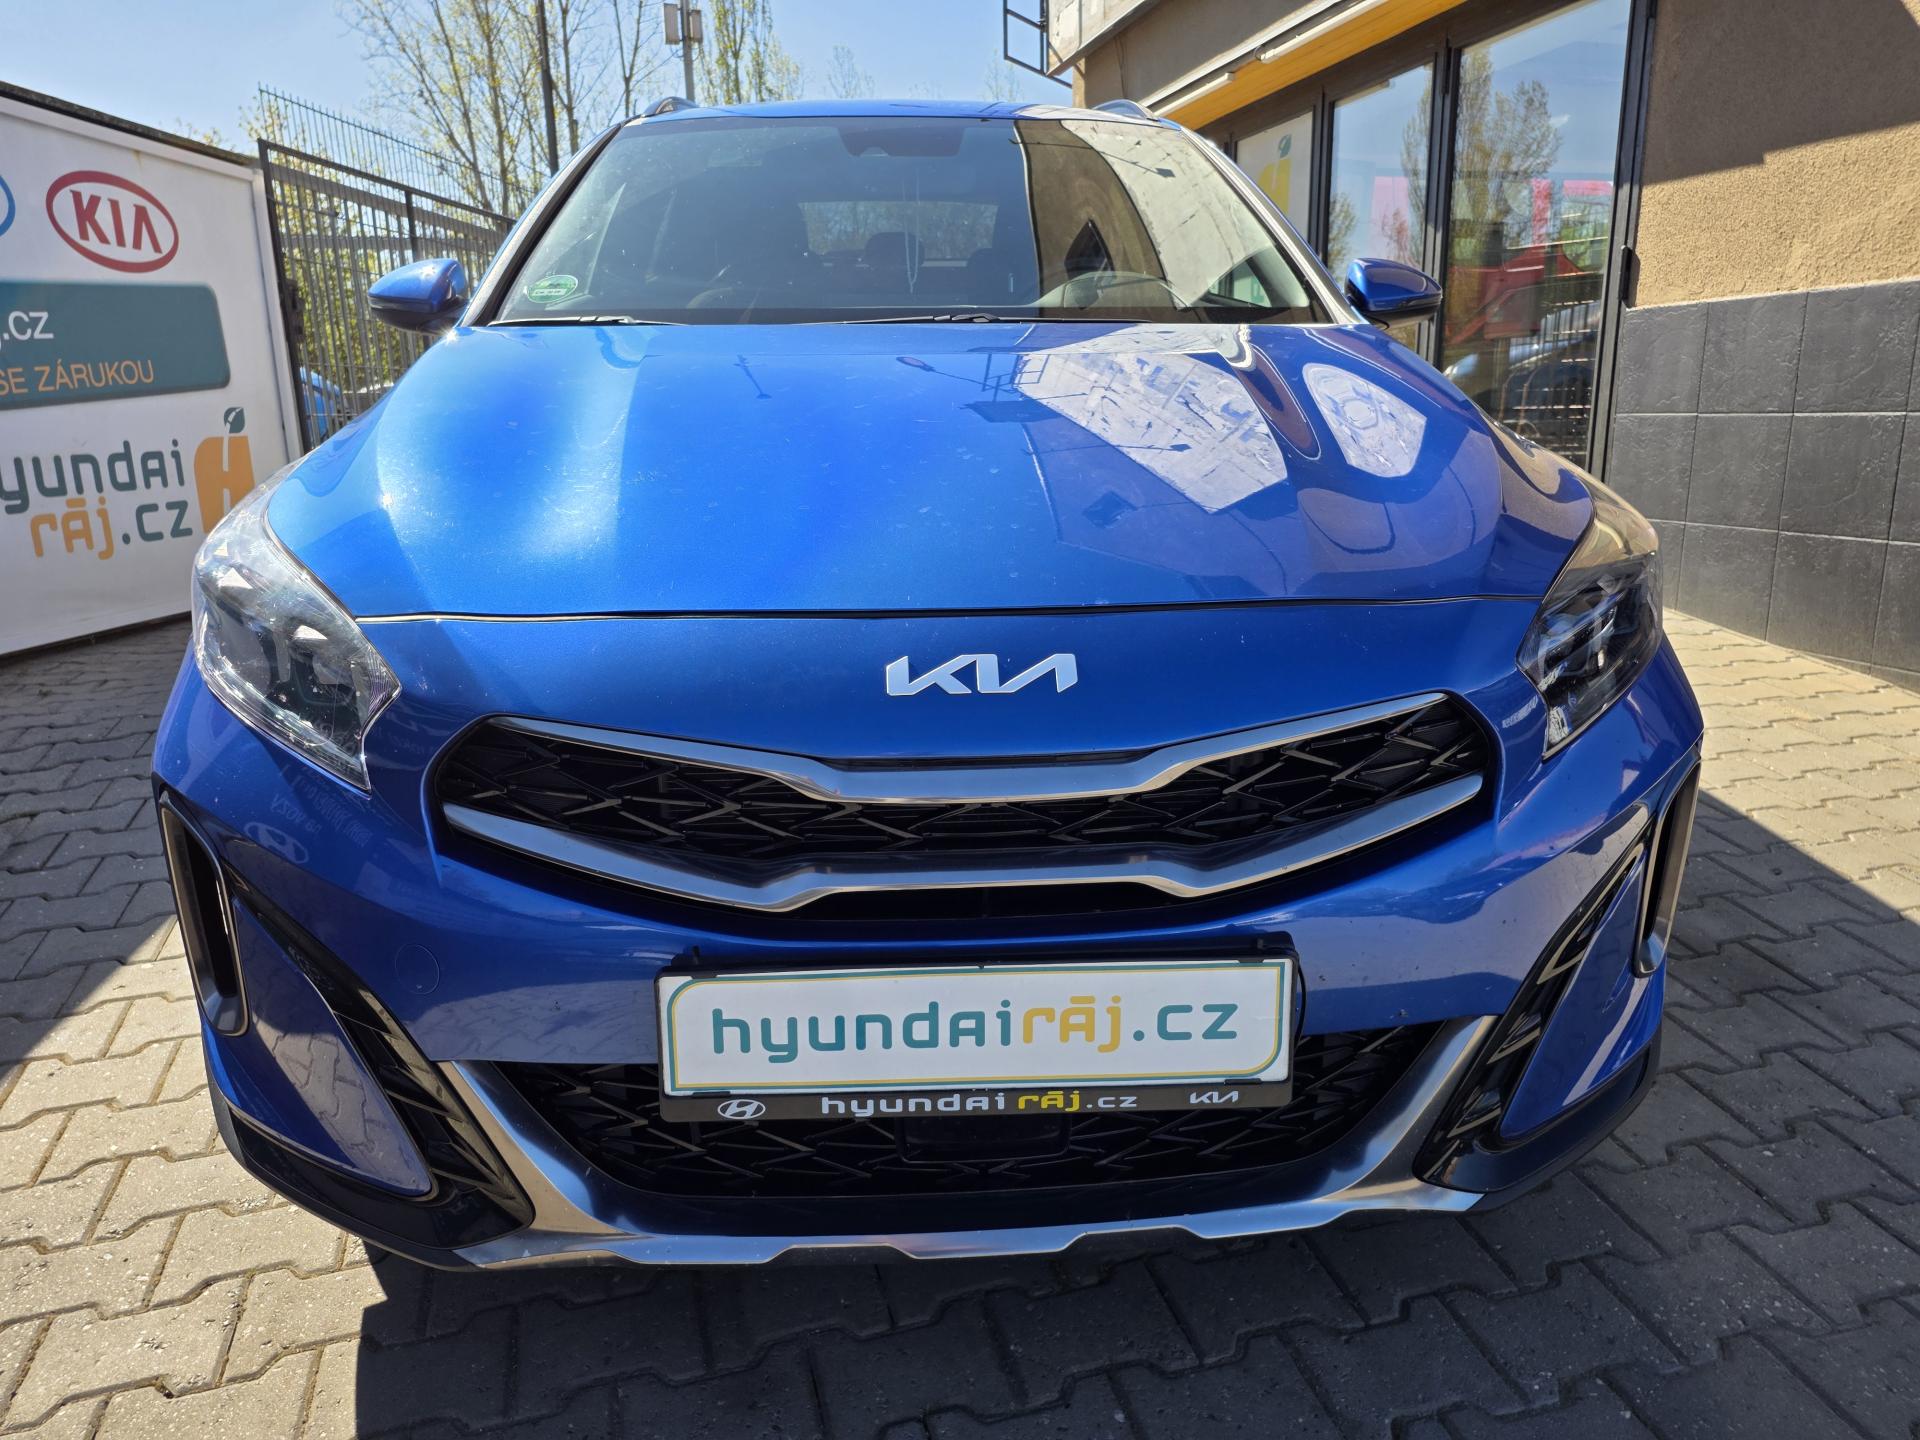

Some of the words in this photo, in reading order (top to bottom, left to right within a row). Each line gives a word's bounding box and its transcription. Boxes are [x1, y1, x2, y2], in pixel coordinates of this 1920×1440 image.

[70, 189, 163, 254] KIA
[34, 359, 154, 393] ZÁRUKOU
[886, 653, 1078, 696] KIA
